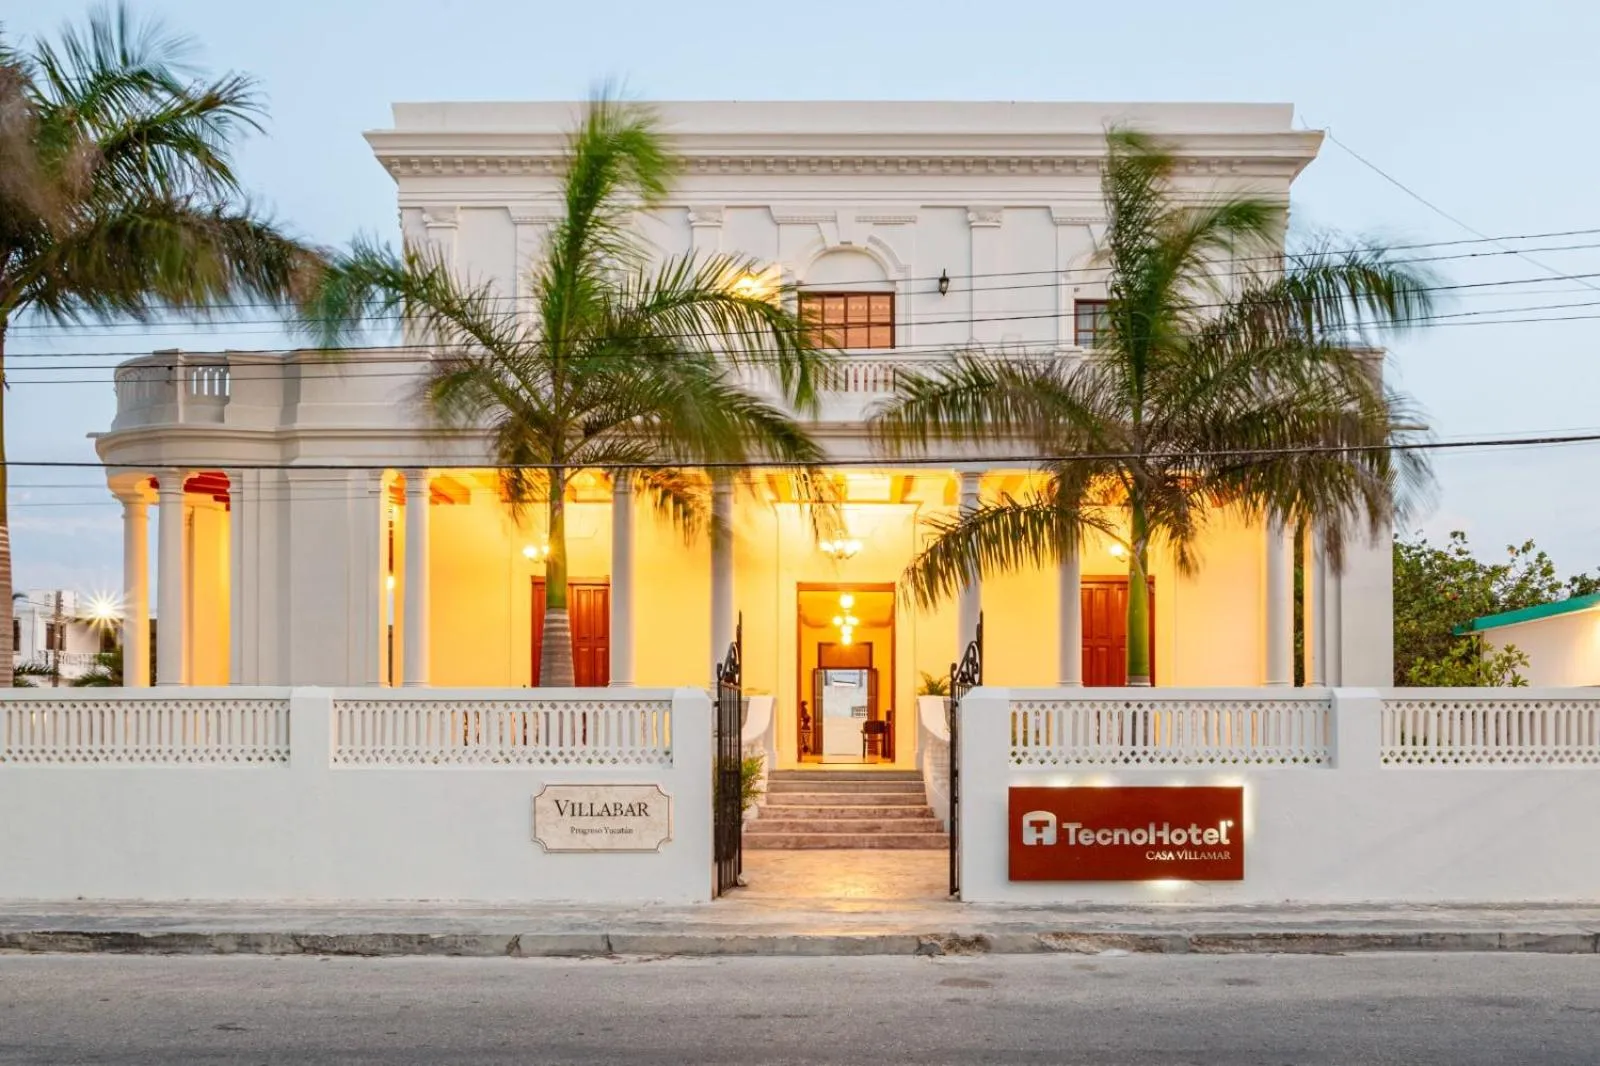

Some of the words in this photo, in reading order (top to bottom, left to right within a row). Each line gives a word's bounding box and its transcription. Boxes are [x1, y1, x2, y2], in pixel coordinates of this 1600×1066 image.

[554, 799, 650, 817] VILLABAR
[1062, 820, 1234, 845] TecnoHotel
[1146, 850, 1175, 861] CASA
[1176, 849, 1231, 860] VILLAMAR
